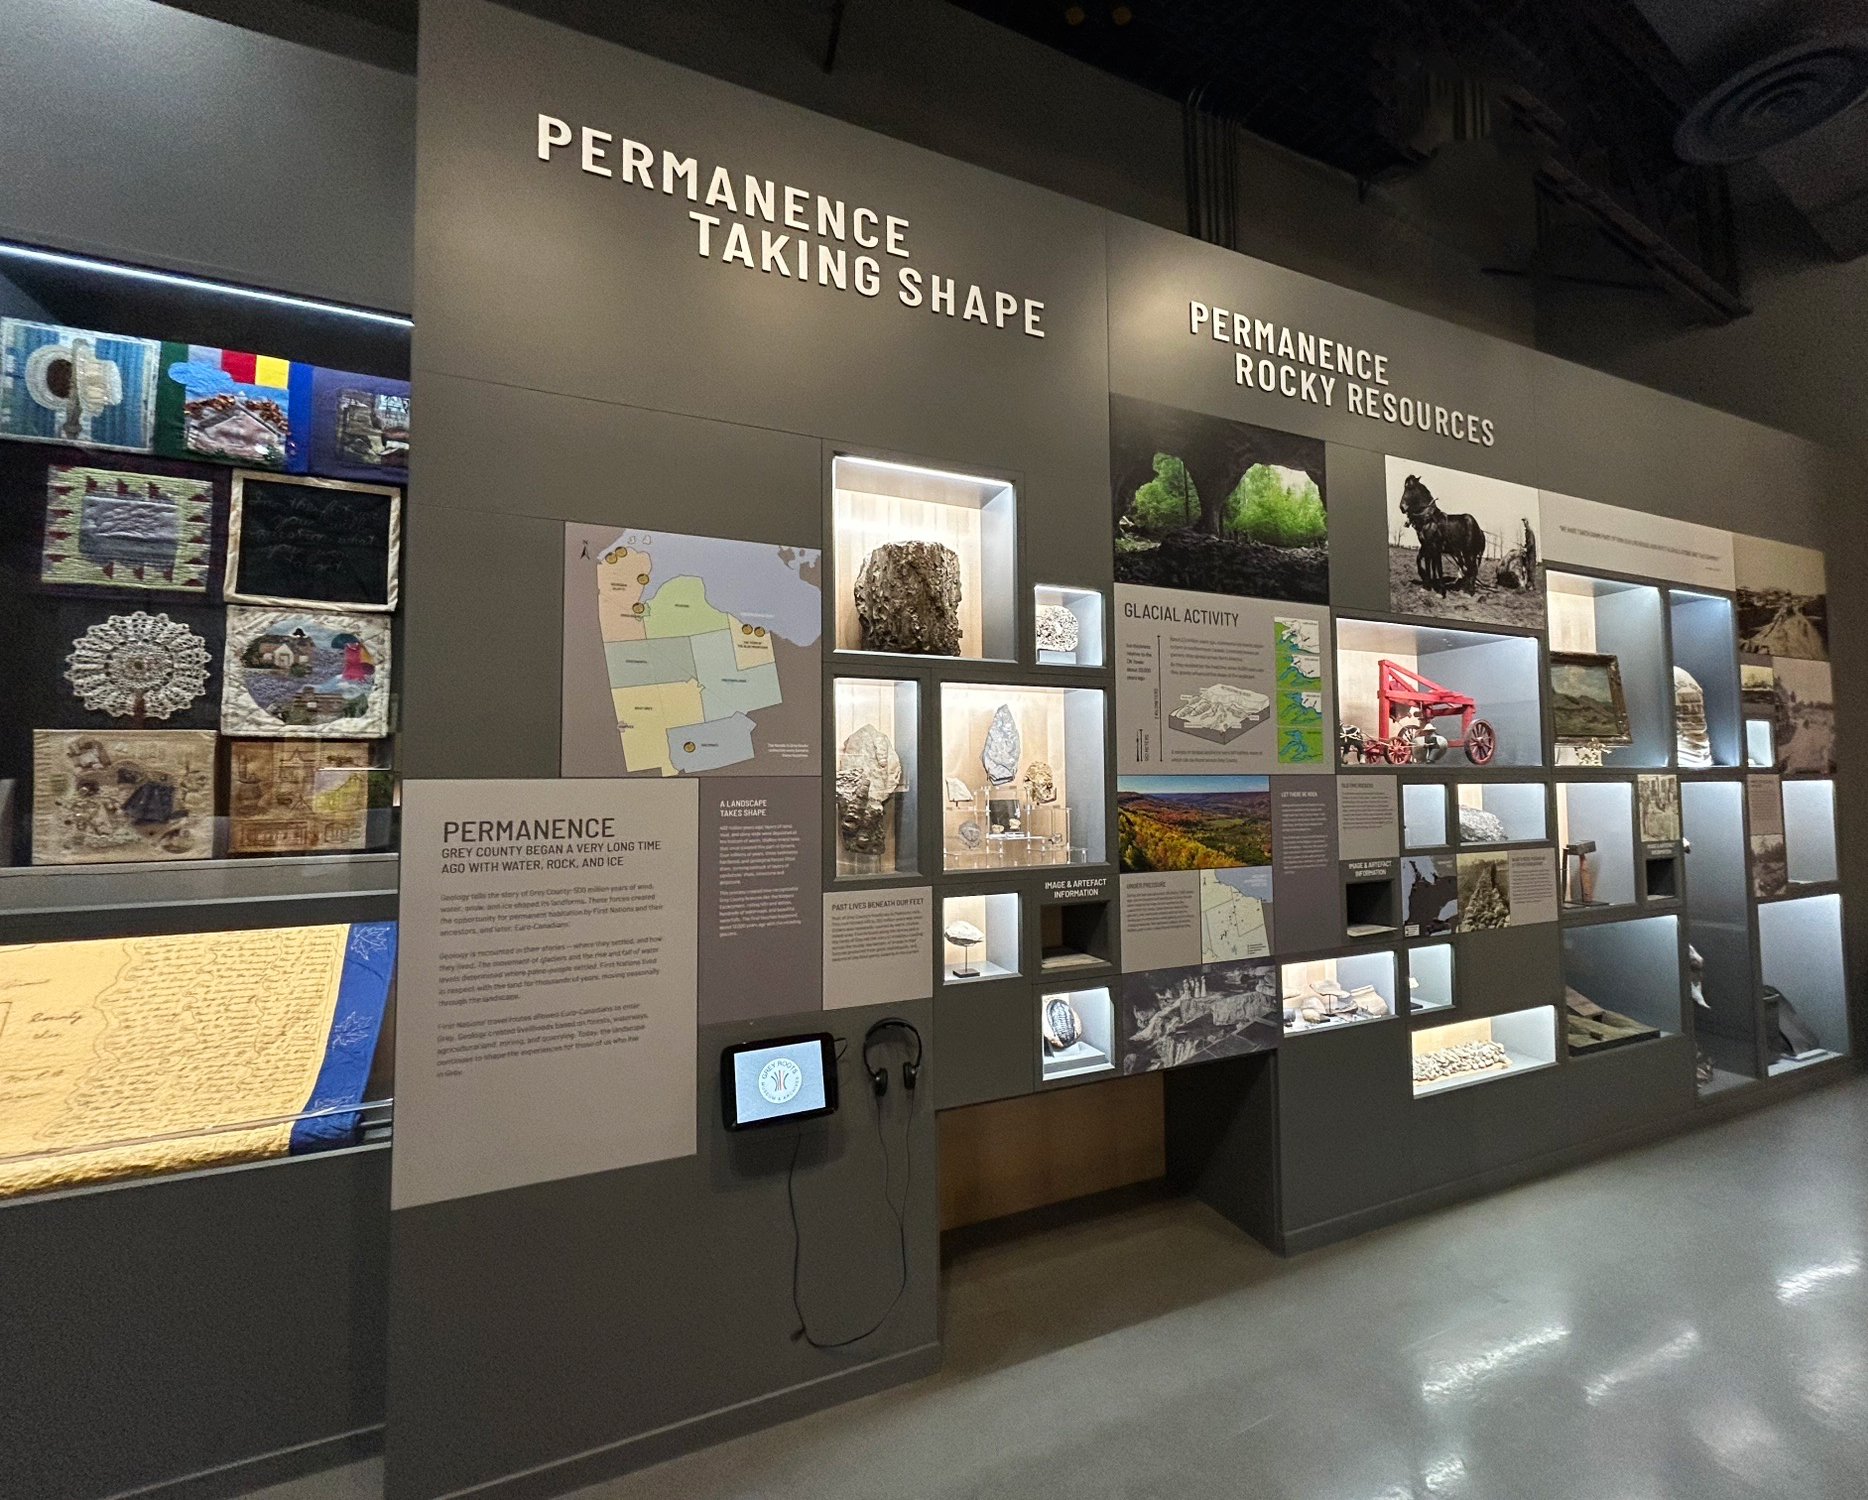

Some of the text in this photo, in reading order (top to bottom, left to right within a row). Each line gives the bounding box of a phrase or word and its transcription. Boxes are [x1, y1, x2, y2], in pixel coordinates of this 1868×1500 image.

[537, 113, 910, 258] PERMANENCE
[689, 211, 1045, 338] TAKING SHAPE
[1190, 301, 1389, 385] PERMANENCE
[1235, 352, 1494, 447] ROCKY RESOURCES
[1124, 602, 1239, 627] GLACIAL ACTIVITY
[720, 808, 767, 817] TAKES SHAPE
[726, 799, 767, 808] LANDSCAPE
[444, 818, 615, 843] PERMANENCE
[441, 840, 661, 859] GREY COUNTY BEGAN A VERY LONG TIME
[441, 856, 624, 873] AGO WITH WATER, ROCK, AND ICE
[1045, 878, 1107, 890] IMAGE & ARTEFACT
[1054, 889, 1099, 898] INFORMATION
[849, 902, 867, 910] LIVES
[868, 900, 895, 909] BENEATH
